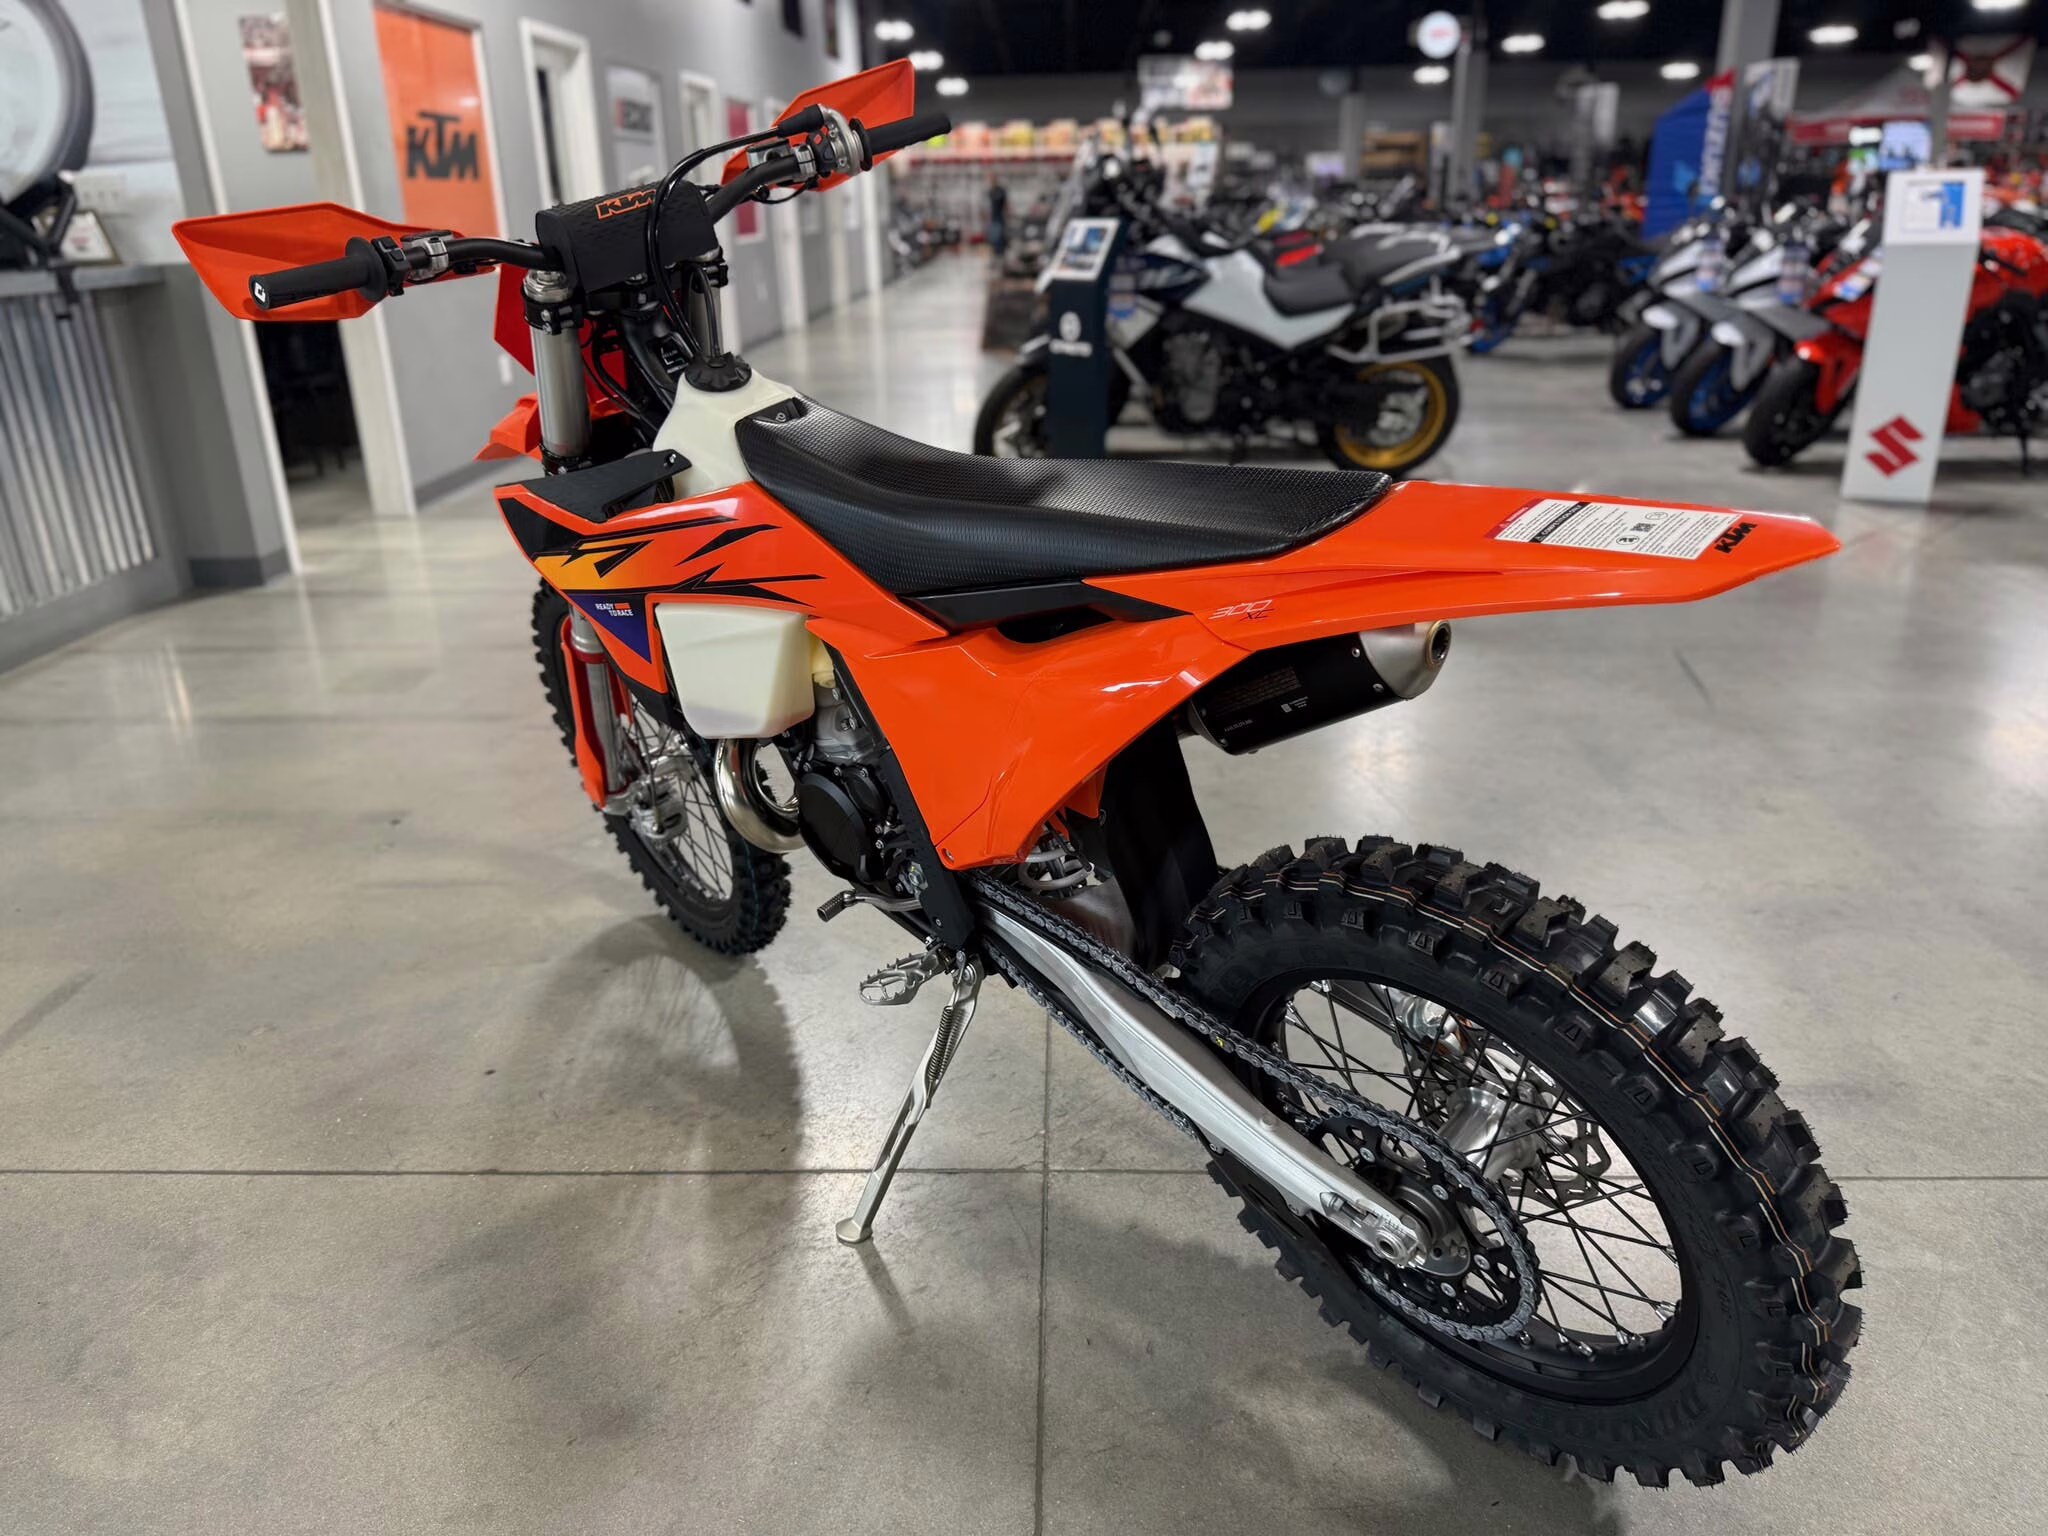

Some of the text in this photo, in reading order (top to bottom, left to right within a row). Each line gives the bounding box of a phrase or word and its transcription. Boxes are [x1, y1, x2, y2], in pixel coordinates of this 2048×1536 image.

[407, 110, 479, 179] KTM
[595, 188, 657, 220] KTM
[1713, 522, 1758, 554] KTM
[617, 609, 634, 617] RACE
[1208, 599, 1273, 620] 300
[1240, 609, 1275, 622] XC
